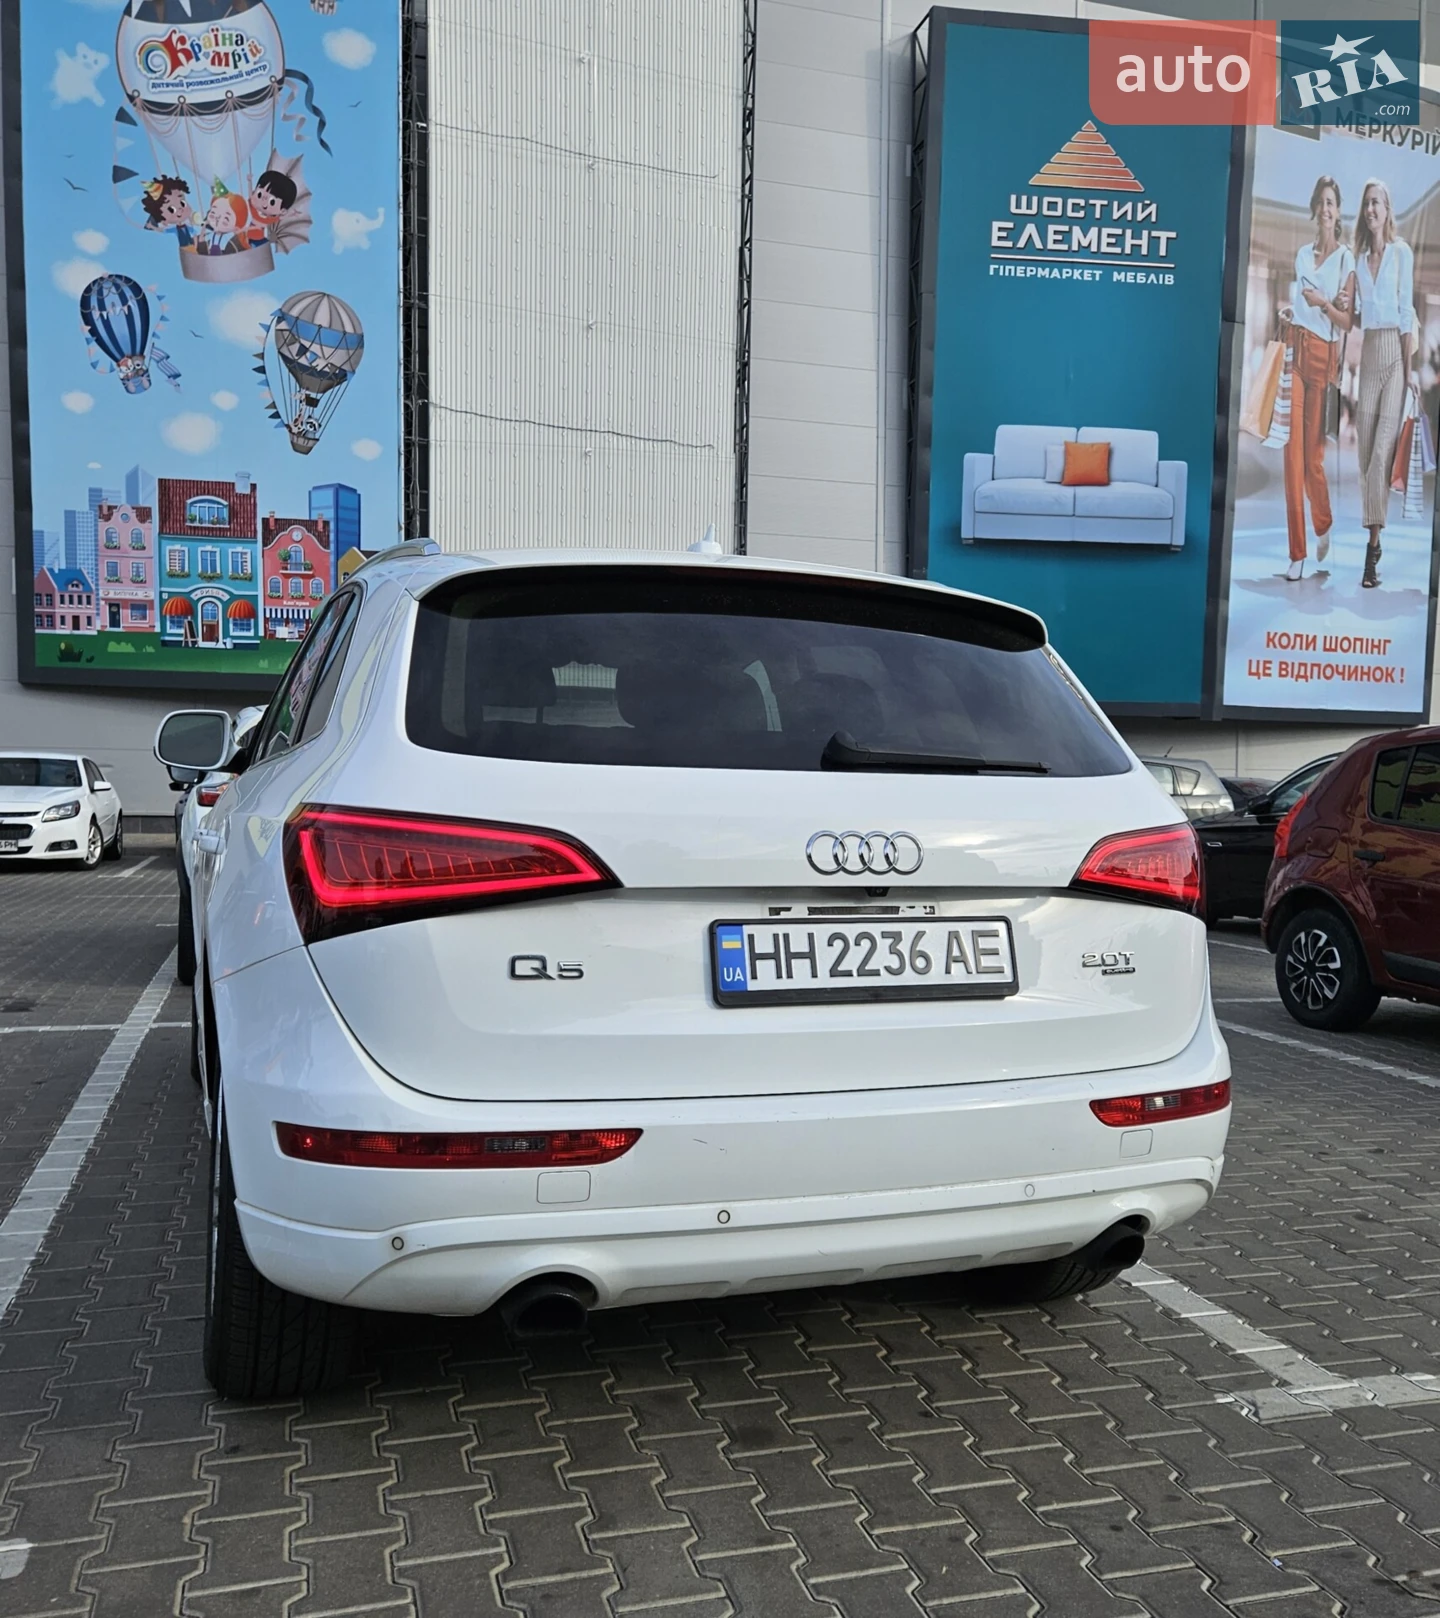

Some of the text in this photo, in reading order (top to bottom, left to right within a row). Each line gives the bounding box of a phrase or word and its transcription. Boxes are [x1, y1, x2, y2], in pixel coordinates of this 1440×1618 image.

[138, 27, 244, 79] Країна
[151, 63, 268, 89] дитячий розважальний центр
[1010, 194, 1157, 223] ШОСТИЙ
[991, 221, 1177, 256] ЕЛЕМЕНТ
[989, 265, 1175, 285] ГІПЕРМАРКЕТ МЕБЛІВ
[1266, 631, 1392, 656] КОЛИ ШОПІНГ
[1247, 659, 1273, 680] ЦЕ
[1278, 660, 1396, 684] ВІДПОЧИНОК
[508, 954, 584, 981] Q5
[748, 929, 1005, 980] HH 2236 AE
[723, 967, 744, 982] UA
